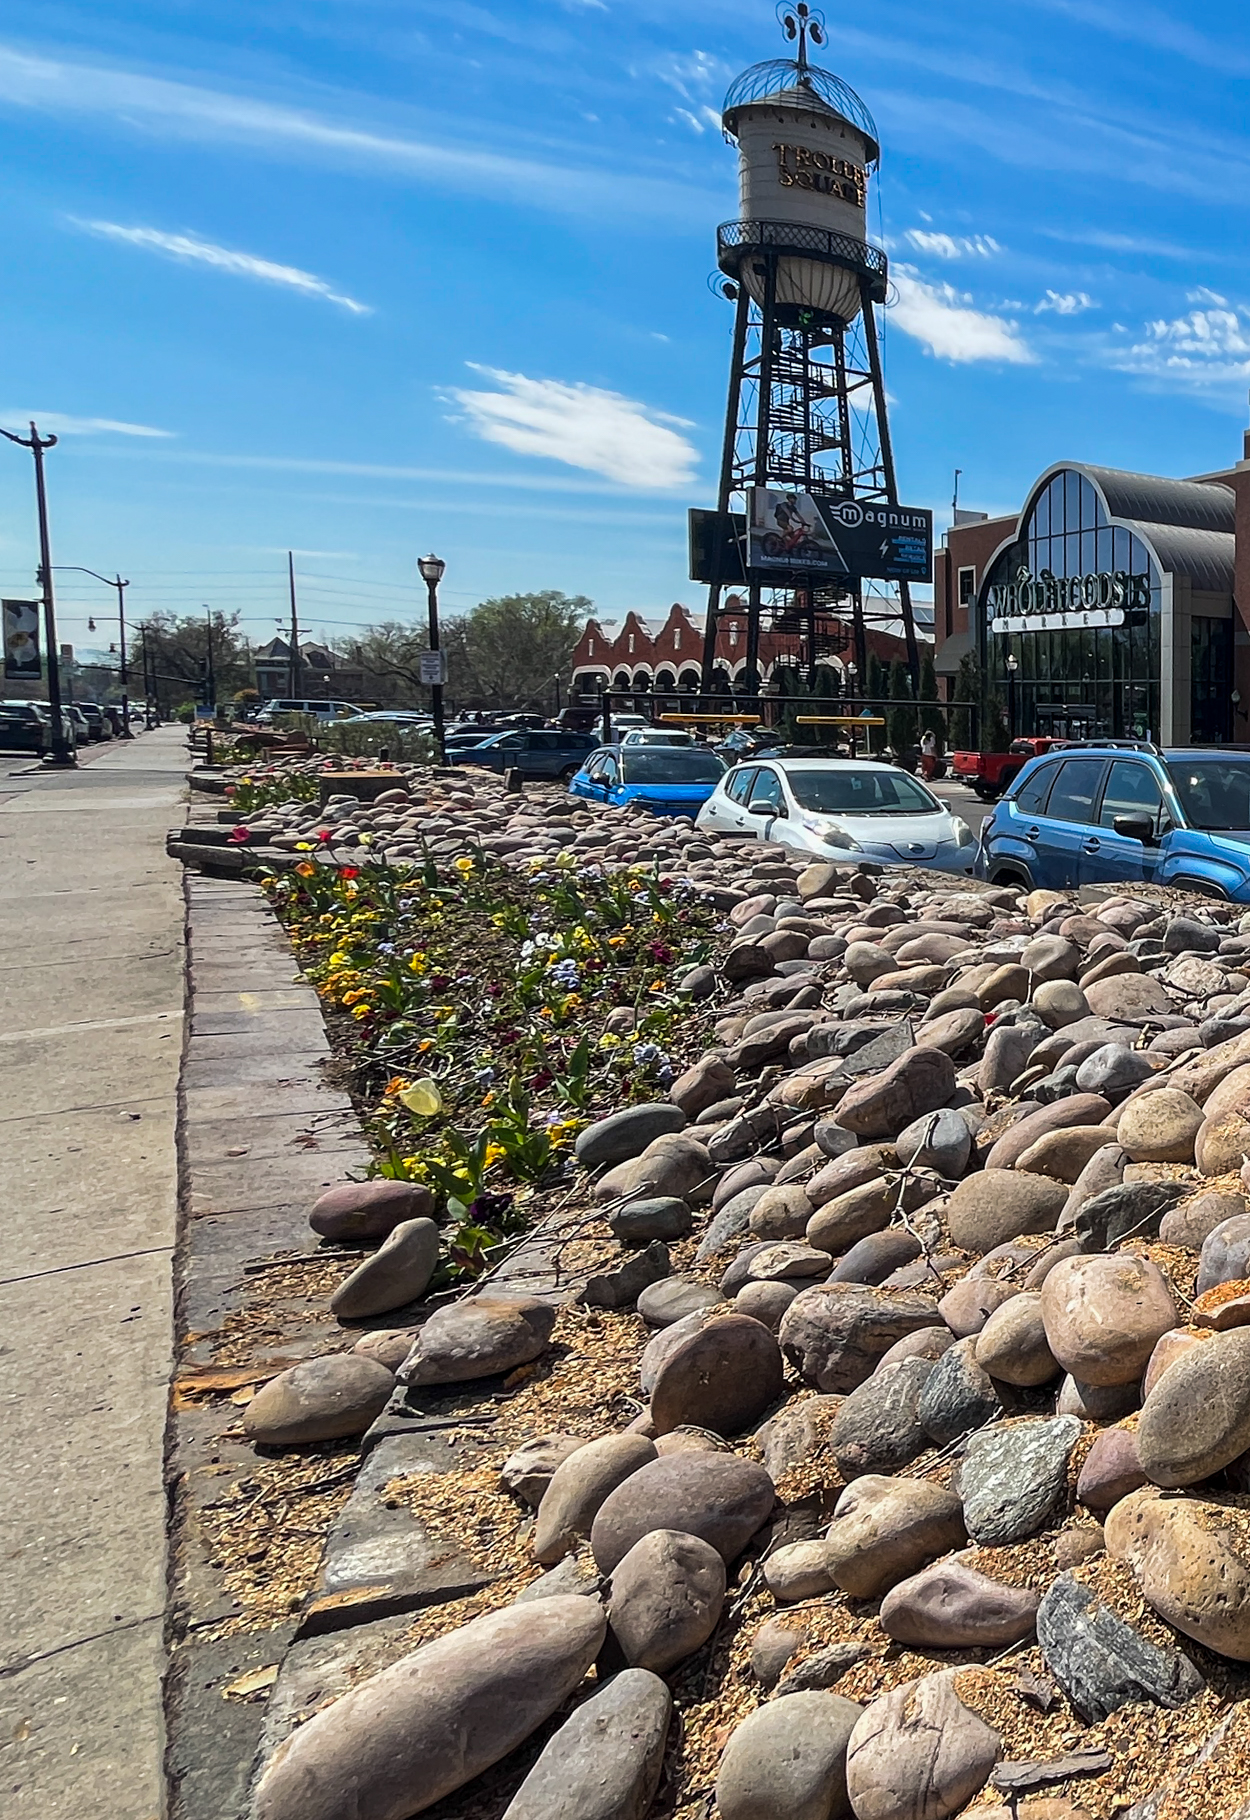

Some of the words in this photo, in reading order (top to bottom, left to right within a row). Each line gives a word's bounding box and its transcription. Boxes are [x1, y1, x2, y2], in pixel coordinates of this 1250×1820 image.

[771, 141, 868, 193] TROLLEY
[841, 507, 927, 529] magnum
[1056, 571, 1125, 611] FOODS
[1002, 610, 1111, 630] MARKET
